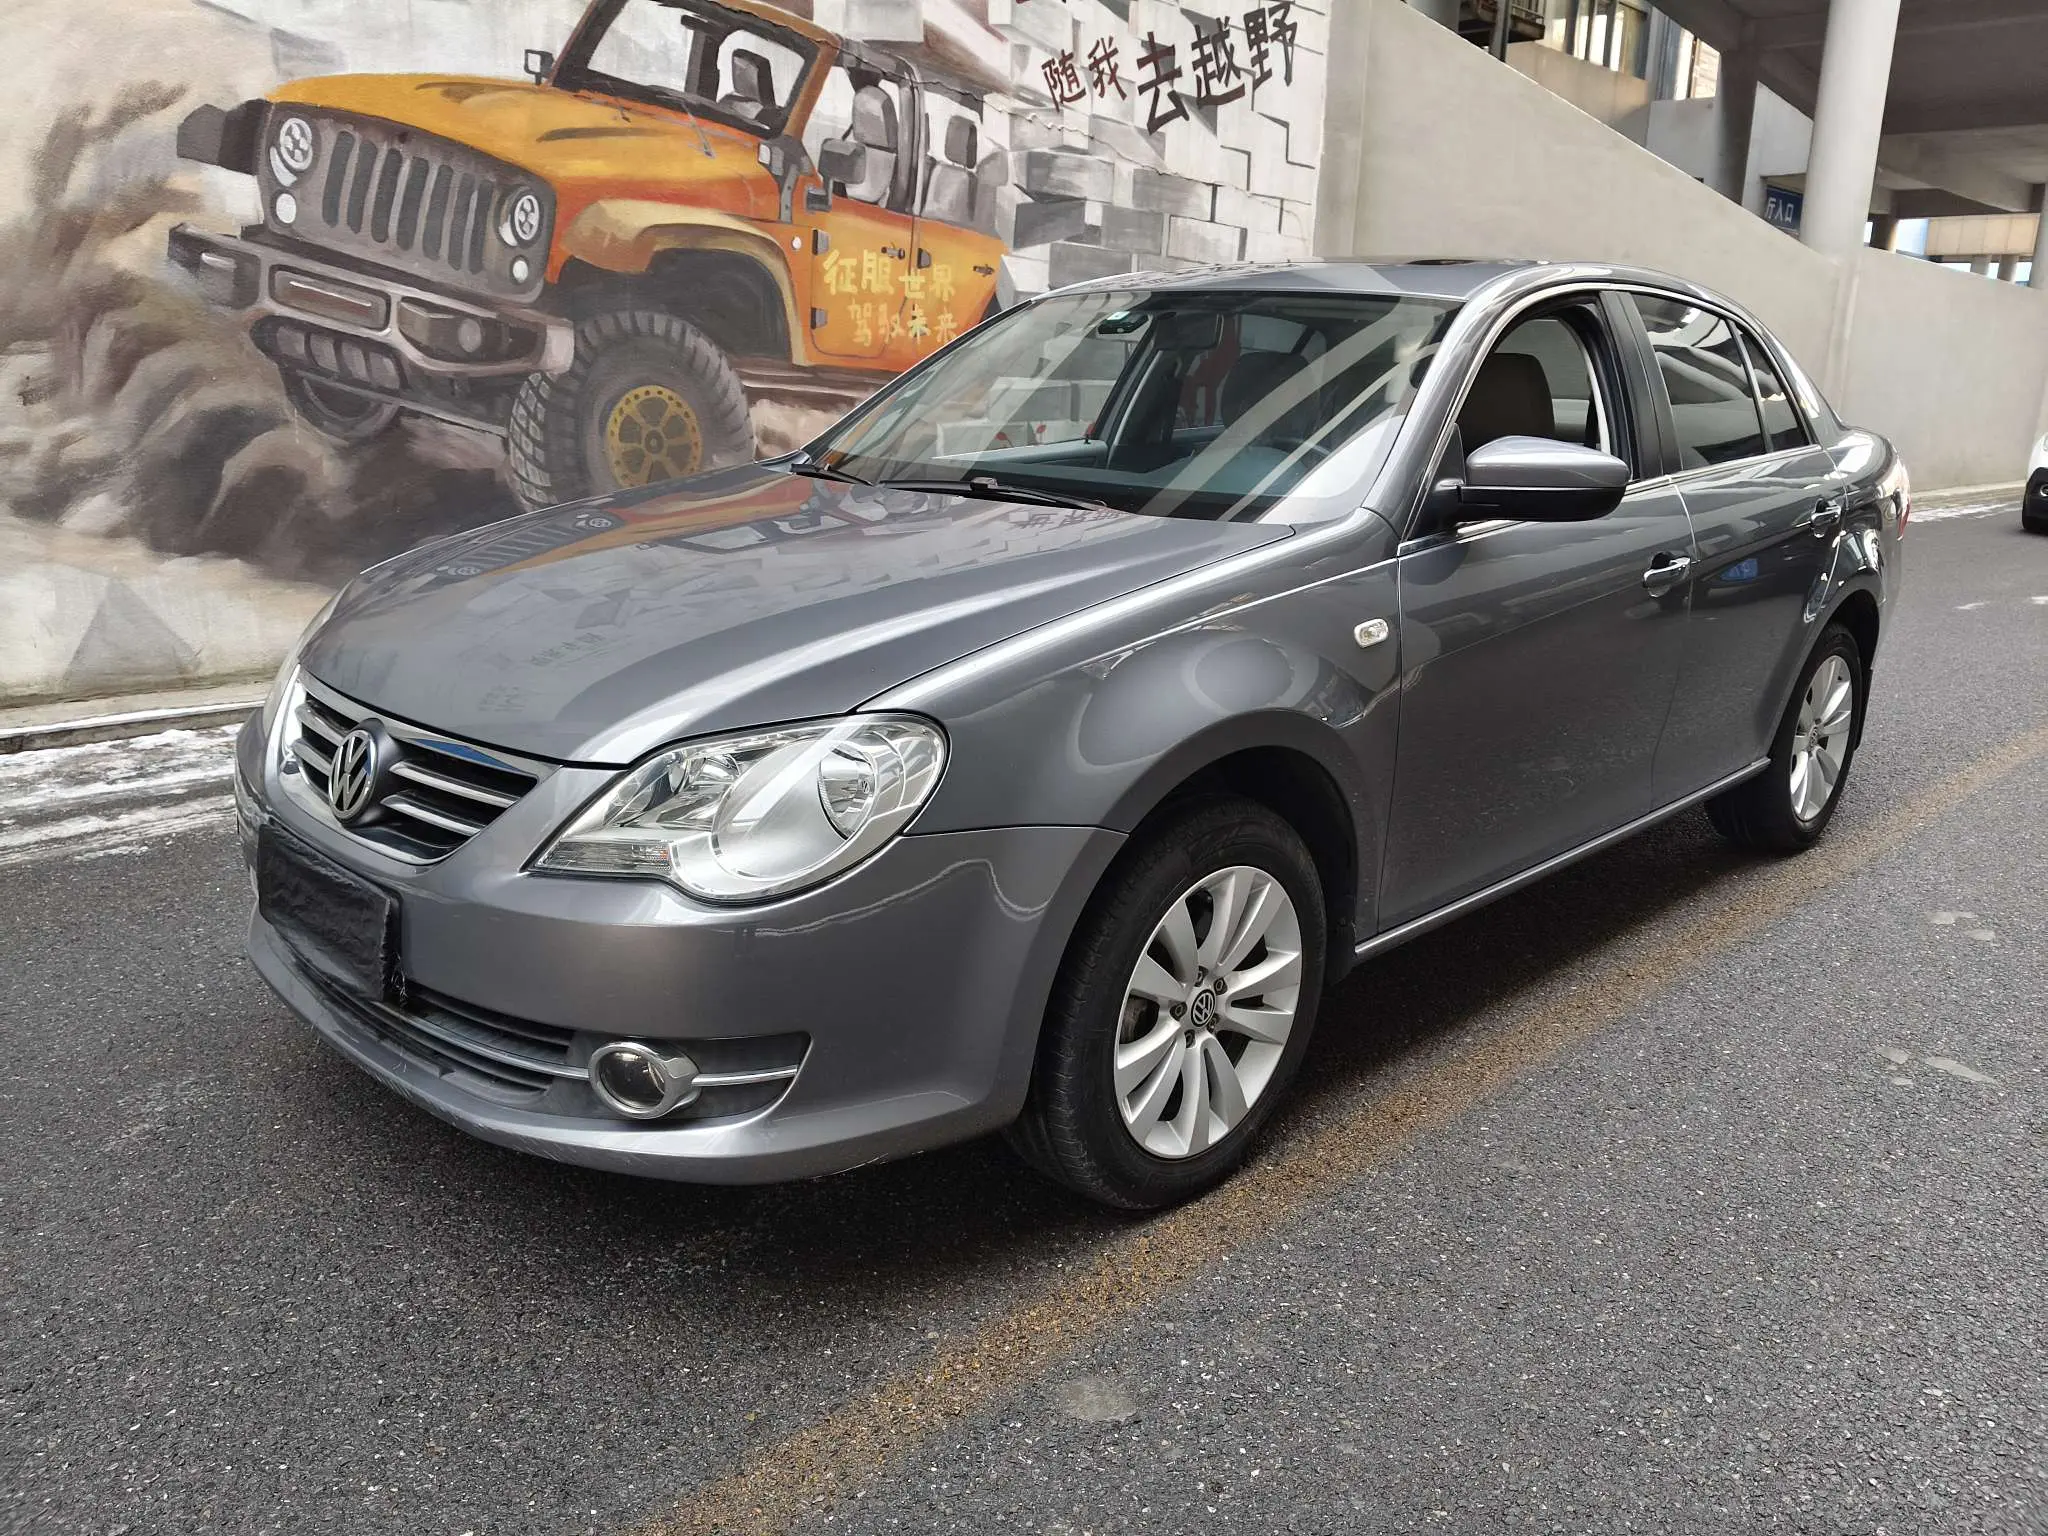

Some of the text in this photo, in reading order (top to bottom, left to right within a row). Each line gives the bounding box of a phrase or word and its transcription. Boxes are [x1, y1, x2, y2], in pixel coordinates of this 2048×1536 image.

[1041, 3, 1298, 135] 随我去越野
[822, 248, 956, 302] 征服世界
[847, 298, 958, 346] 驾驭未来
